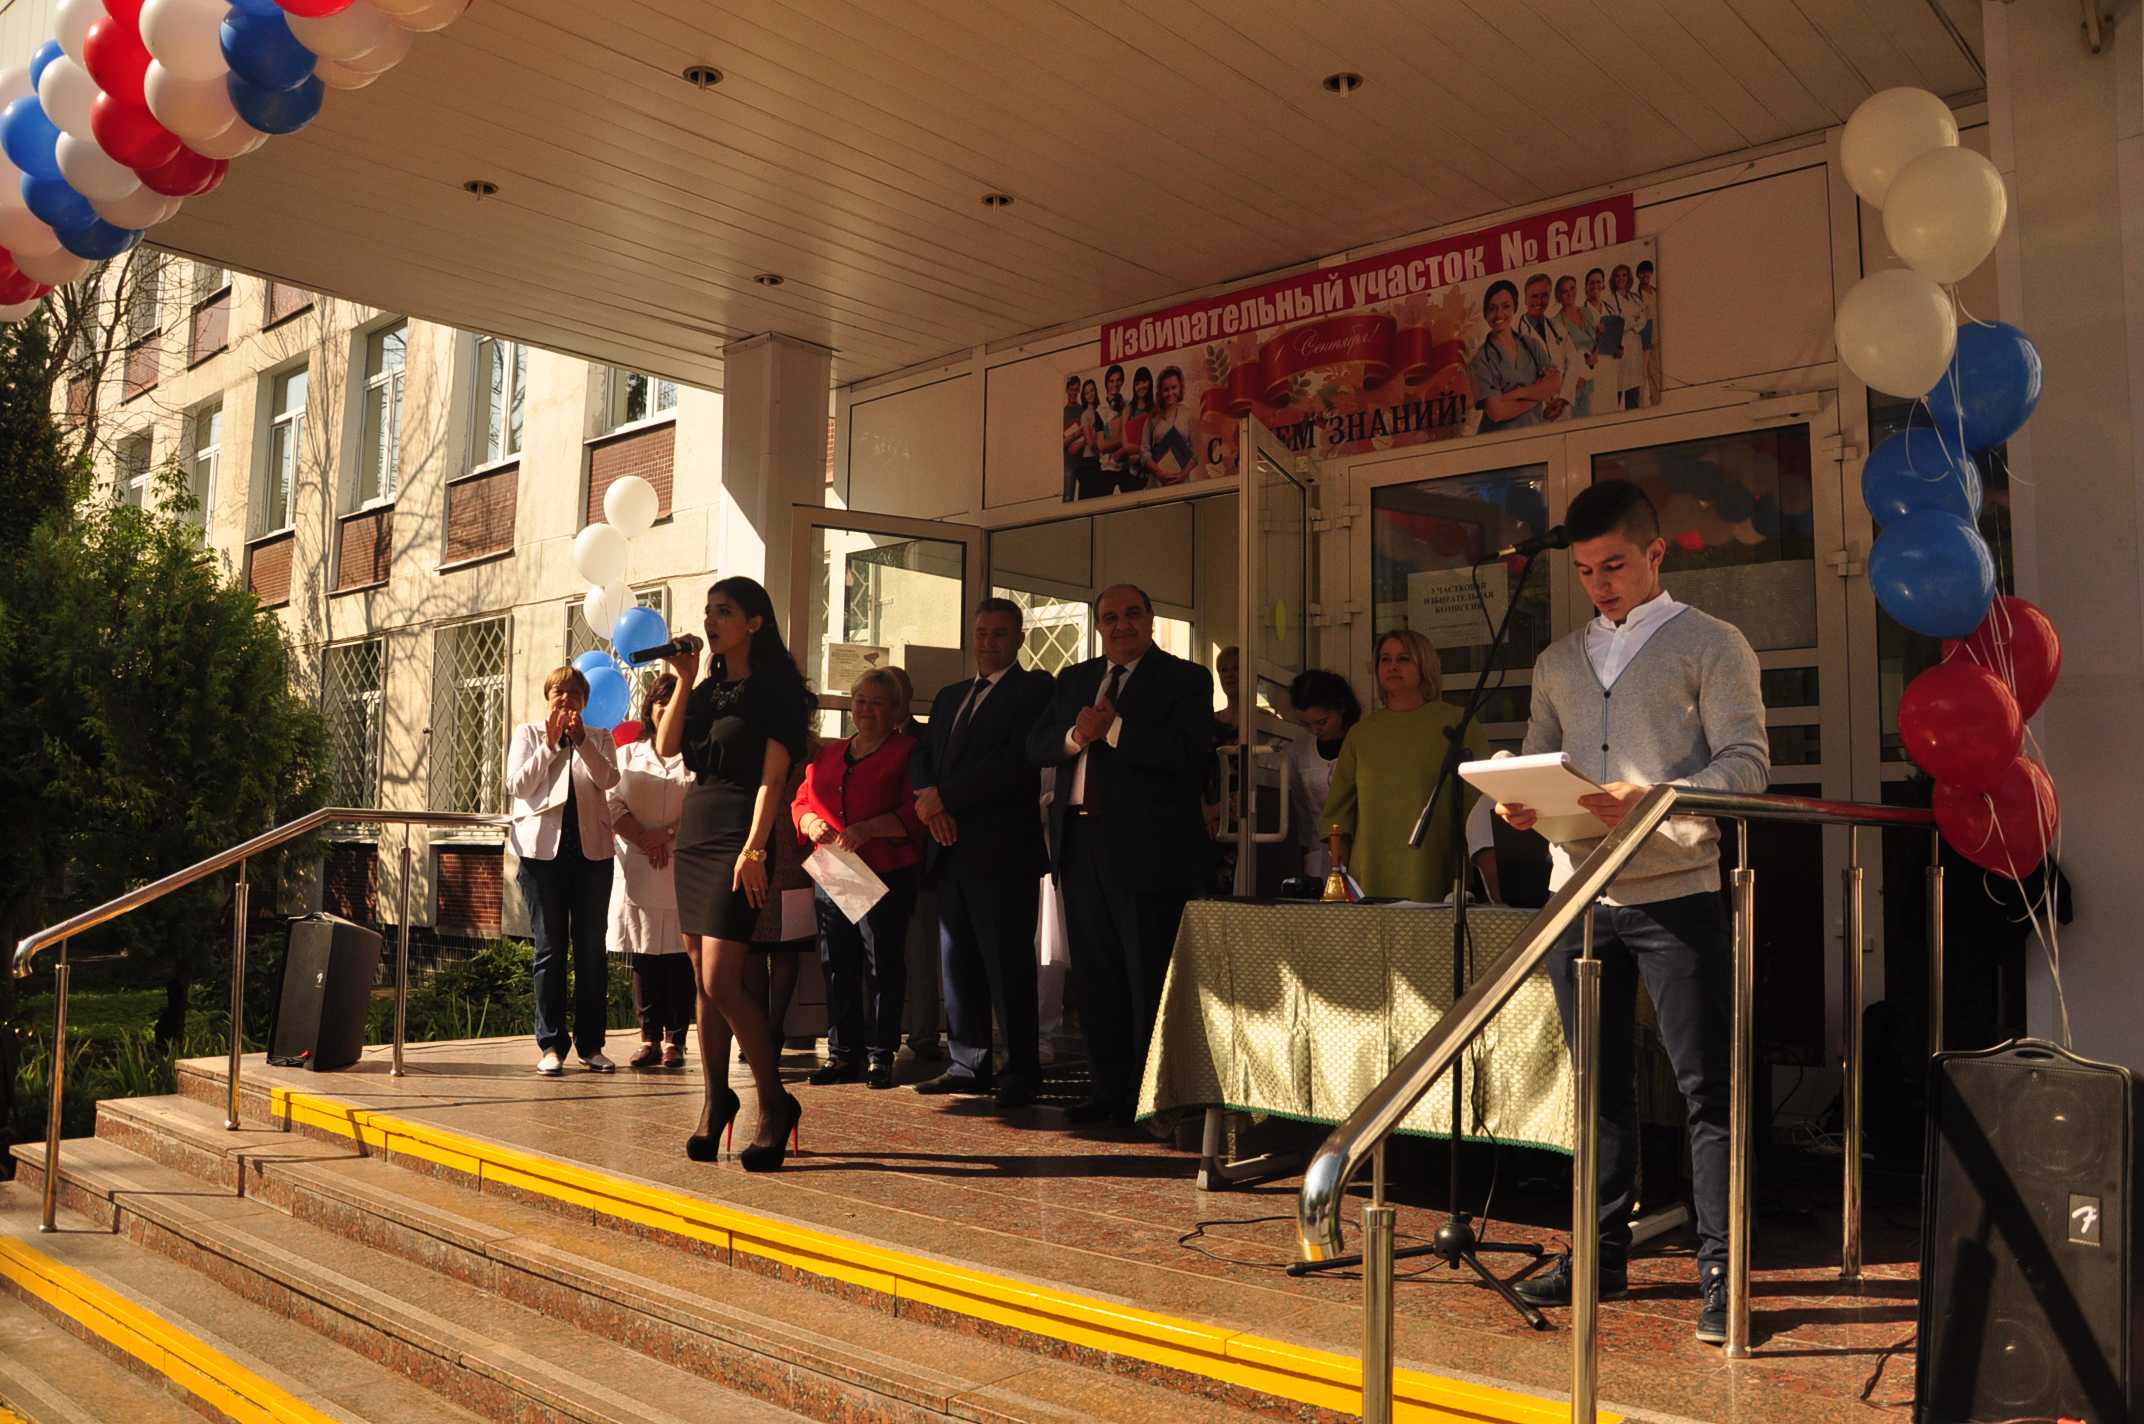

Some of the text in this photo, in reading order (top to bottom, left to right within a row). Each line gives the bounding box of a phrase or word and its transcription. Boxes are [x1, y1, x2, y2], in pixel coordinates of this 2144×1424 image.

[1109, 211, 1617, 361] Избирательный участок № 640
[1329, 390, 1468, 445] ЗНАНИЙ!
